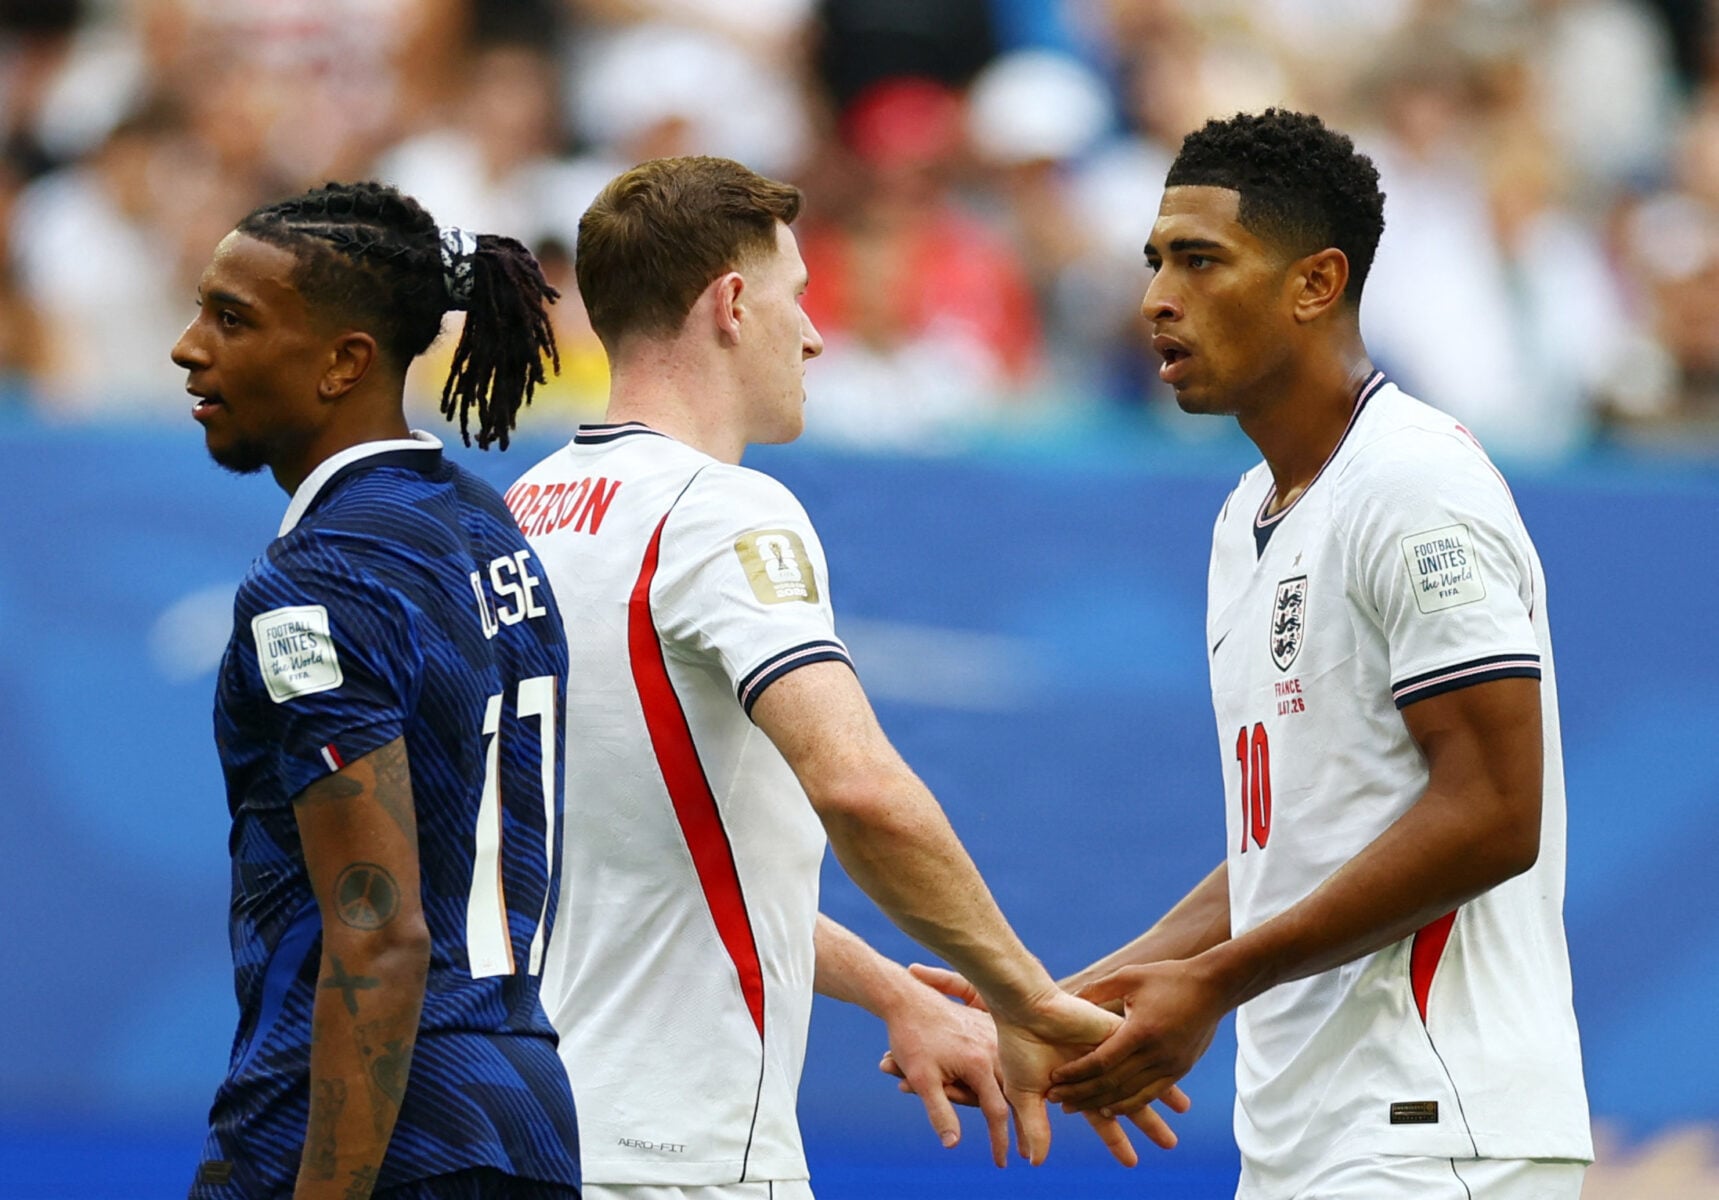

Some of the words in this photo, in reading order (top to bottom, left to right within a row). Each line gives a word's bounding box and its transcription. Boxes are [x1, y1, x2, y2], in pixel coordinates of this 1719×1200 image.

[1414, 536, 1463, 558] FOOTBALL
[1417, 549, 1467, 576] UNITES
[1420, 576, 1440, 593] the
[1440, 566, 1473, 587] World
[1439, 587, 1459, 599] FIFA
[266, 620, 312, 641] FOOTBALL
[268, 632, 318, 659] UNITES
[271, 660, 290, 676] the
[289, 650, 325, 671] World
[289, 671, 310, 682] FIFA
[1274, 678, 1303, 699] FRANCE
[1236, 721, 1272, 854] 10
[466, 674, 558, 980] 11
[617, 1137, 688, 1153] AERO-FIT
